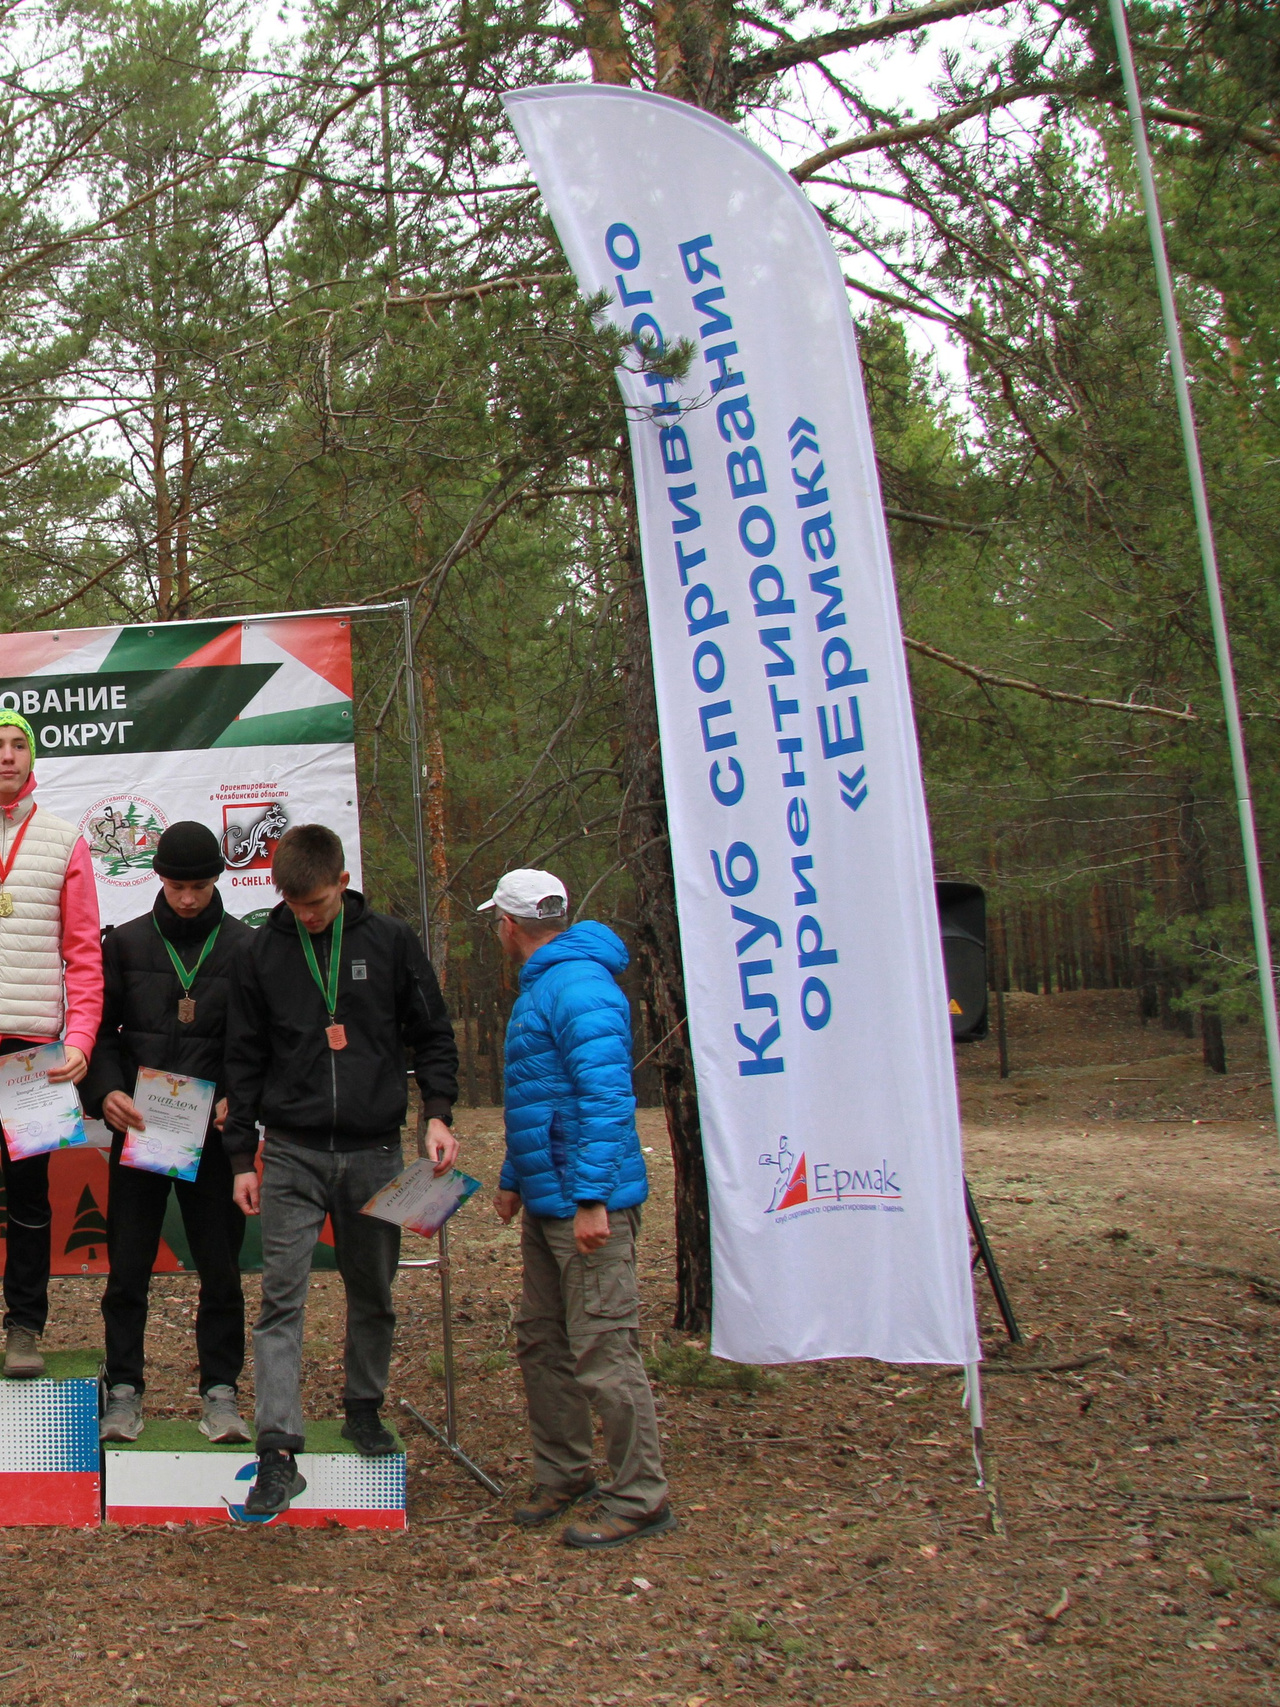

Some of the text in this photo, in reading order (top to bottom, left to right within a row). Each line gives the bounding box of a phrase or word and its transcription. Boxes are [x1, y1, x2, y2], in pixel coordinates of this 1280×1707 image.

[787, 417, 869, 812] «Ермак»
[678, 234, 837, 1031] ориентирования
[605, 222, 786, 1077] Клуб спортивного
[40, 720, 134, 749] ОКРУГ
[215, 791, 259, 801] Челябинской
[261, 789, 289, 798] области
[220, 782, 278, 792] Ориентирование
[231, 875, 272, 887] O-CHEL.R
[148, 1094, 199, 1112] ДИПЛОМ
[814, 1159, 901, 1202] Ермак
